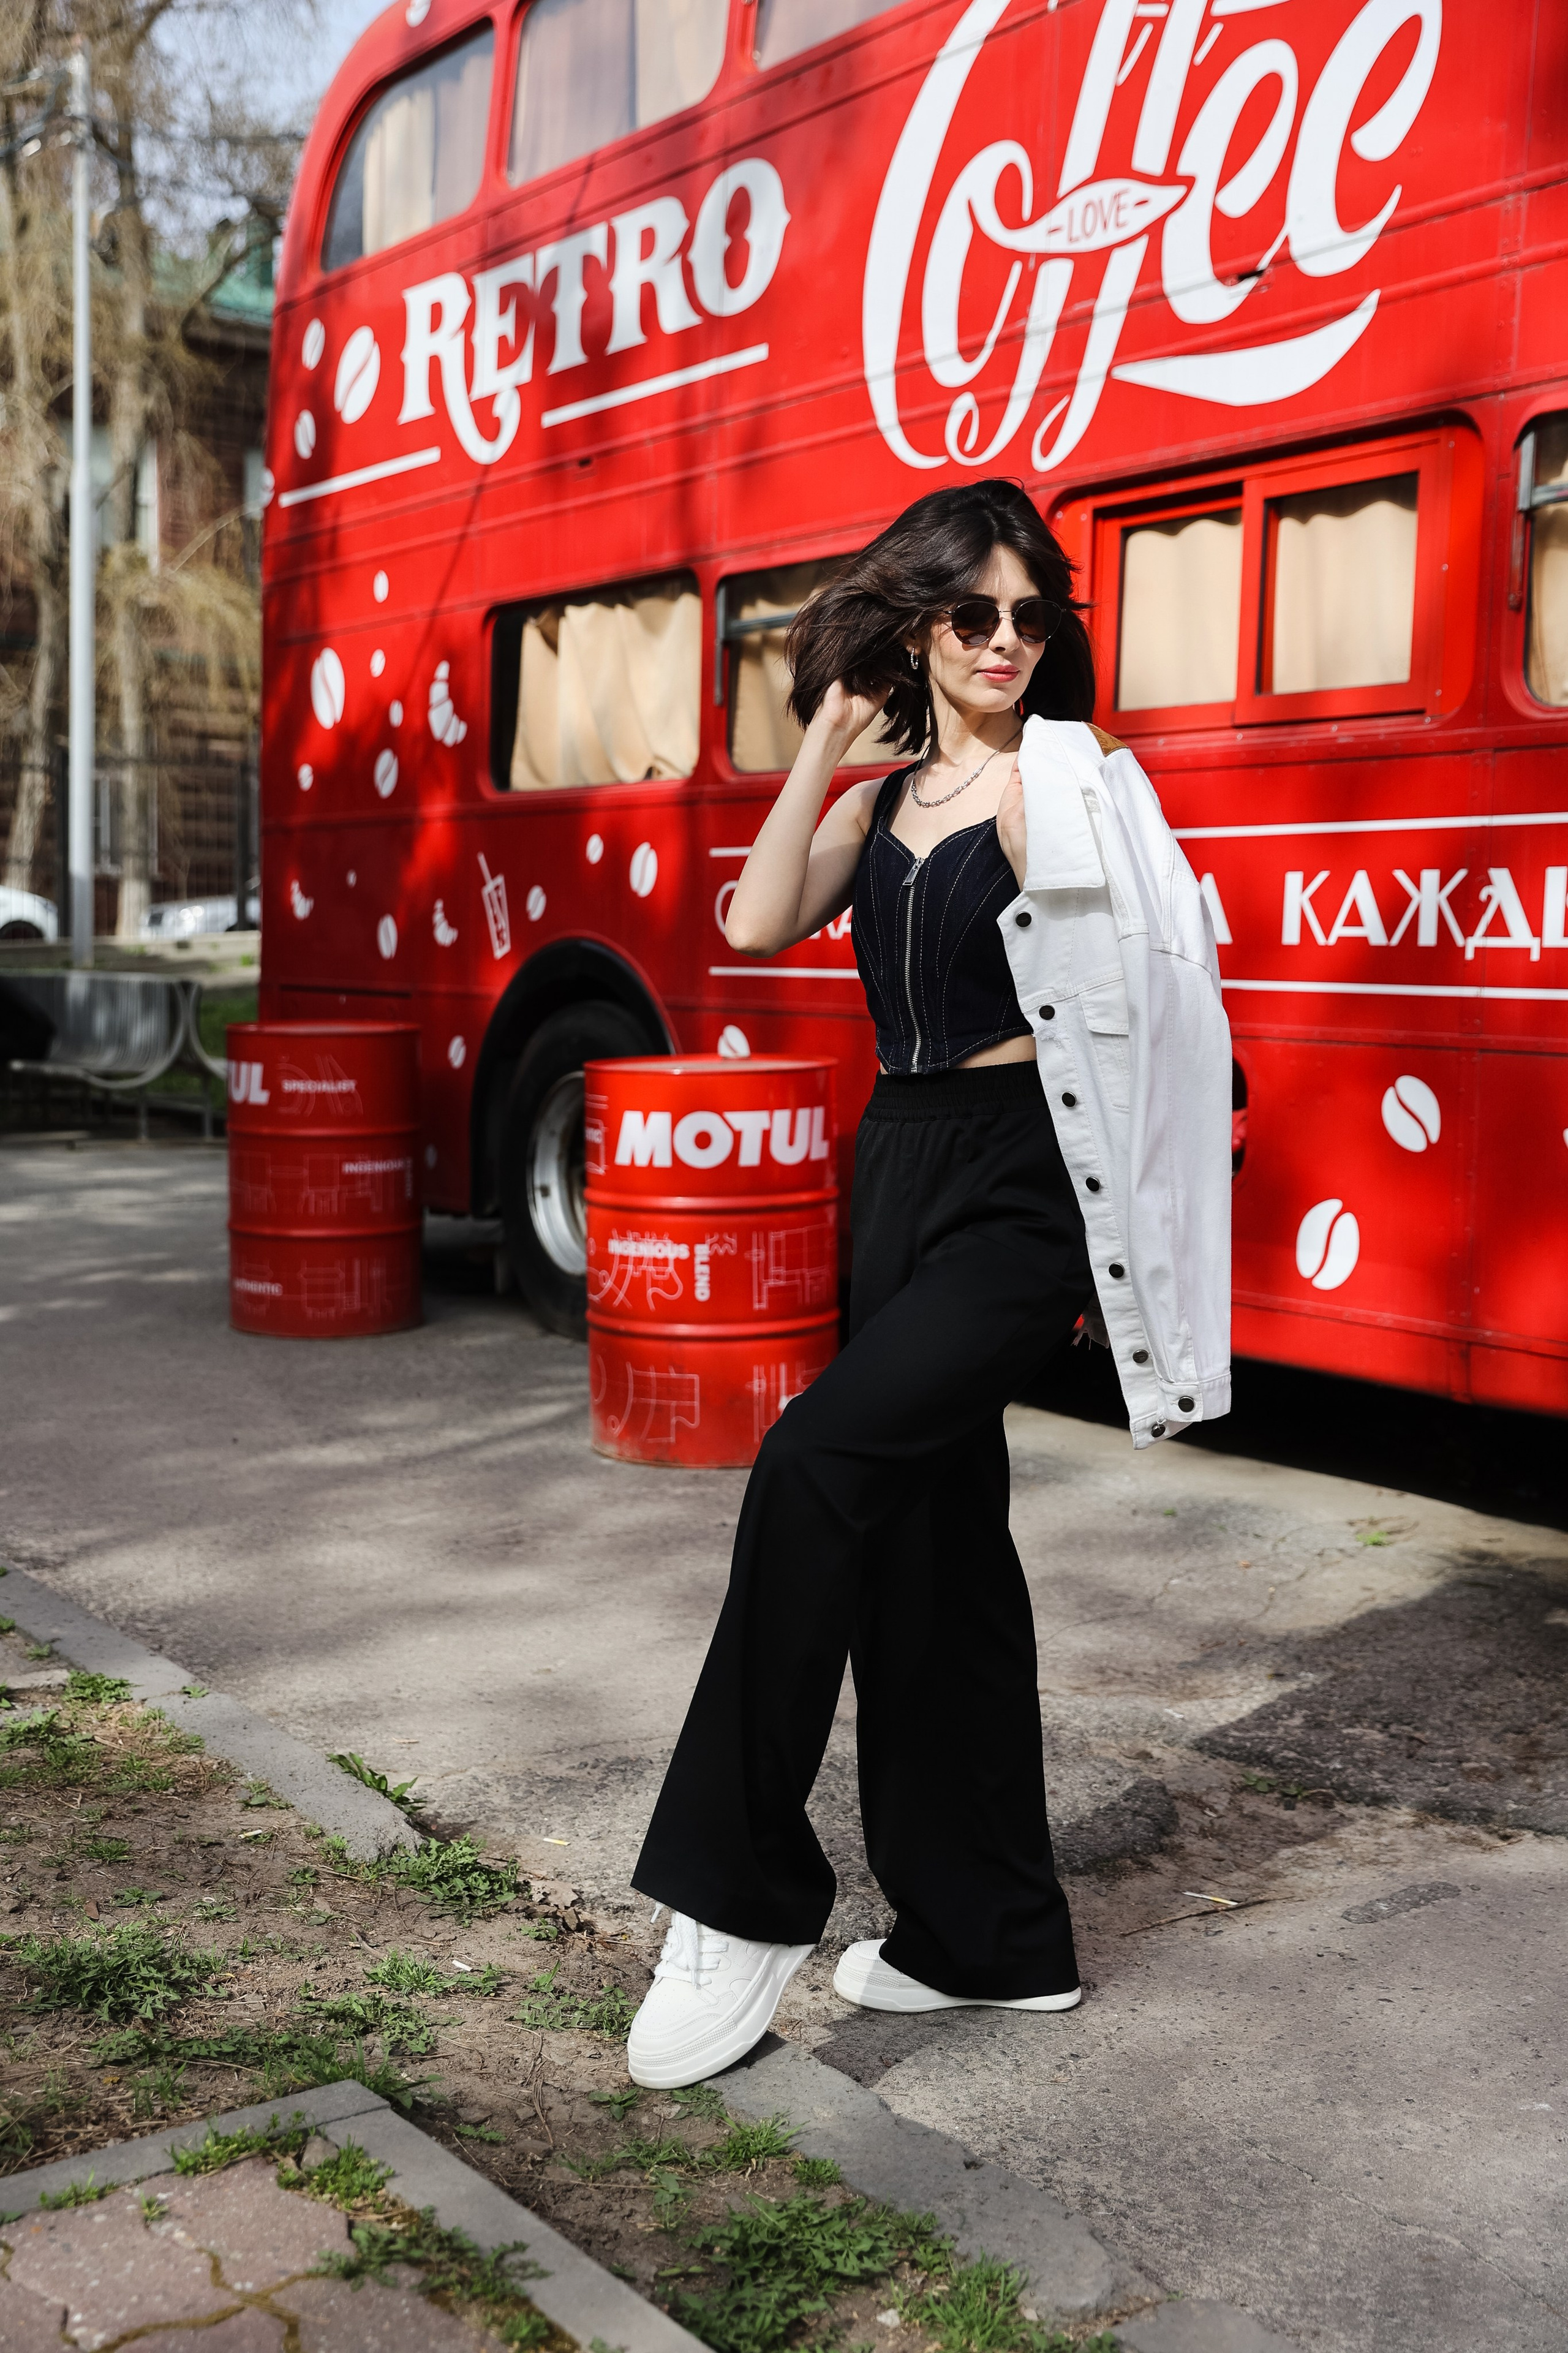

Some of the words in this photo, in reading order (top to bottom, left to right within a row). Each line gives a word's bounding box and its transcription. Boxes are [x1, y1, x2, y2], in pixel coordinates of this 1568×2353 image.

[397, 157, 791, 465] RETRO
[862, 0, 1442, 472] Coffee
[614, 1106, 829, 1169] MOTUL
[694, 1244, 710, 1302] BLEND
